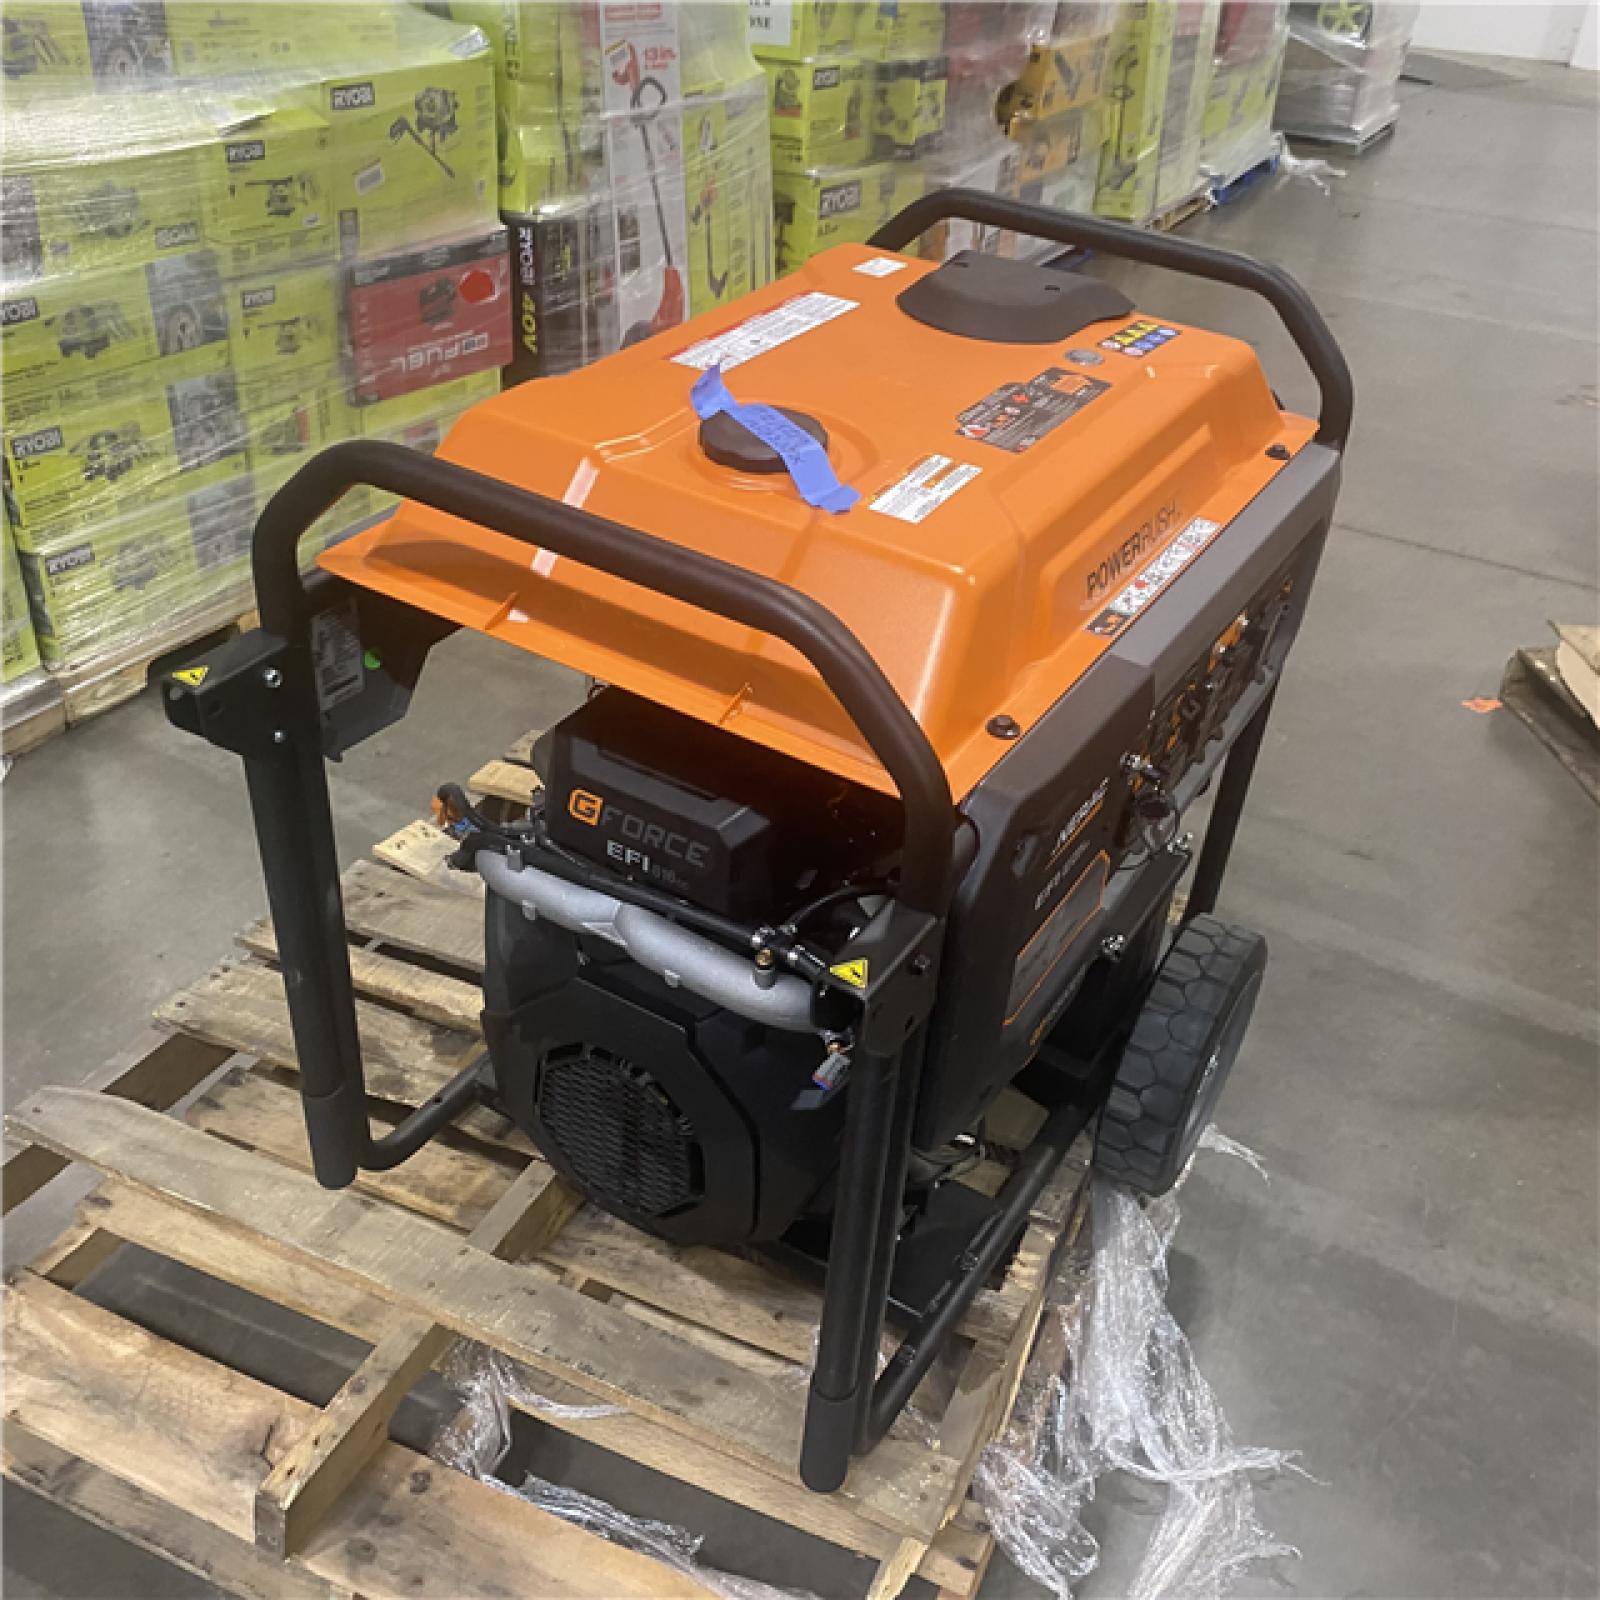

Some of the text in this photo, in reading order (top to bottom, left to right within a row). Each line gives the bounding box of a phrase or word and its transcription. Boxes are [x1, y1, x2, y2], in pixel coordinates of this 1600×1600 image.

[334, 85, 372, 107] RYOBI
[519, 227, 538, 355] RYOBI 40V
[13, 427, 62, 458] RYOBI
[48, 547, 92, 575] RYOBI
[606, 839, 650, 873] EFI
